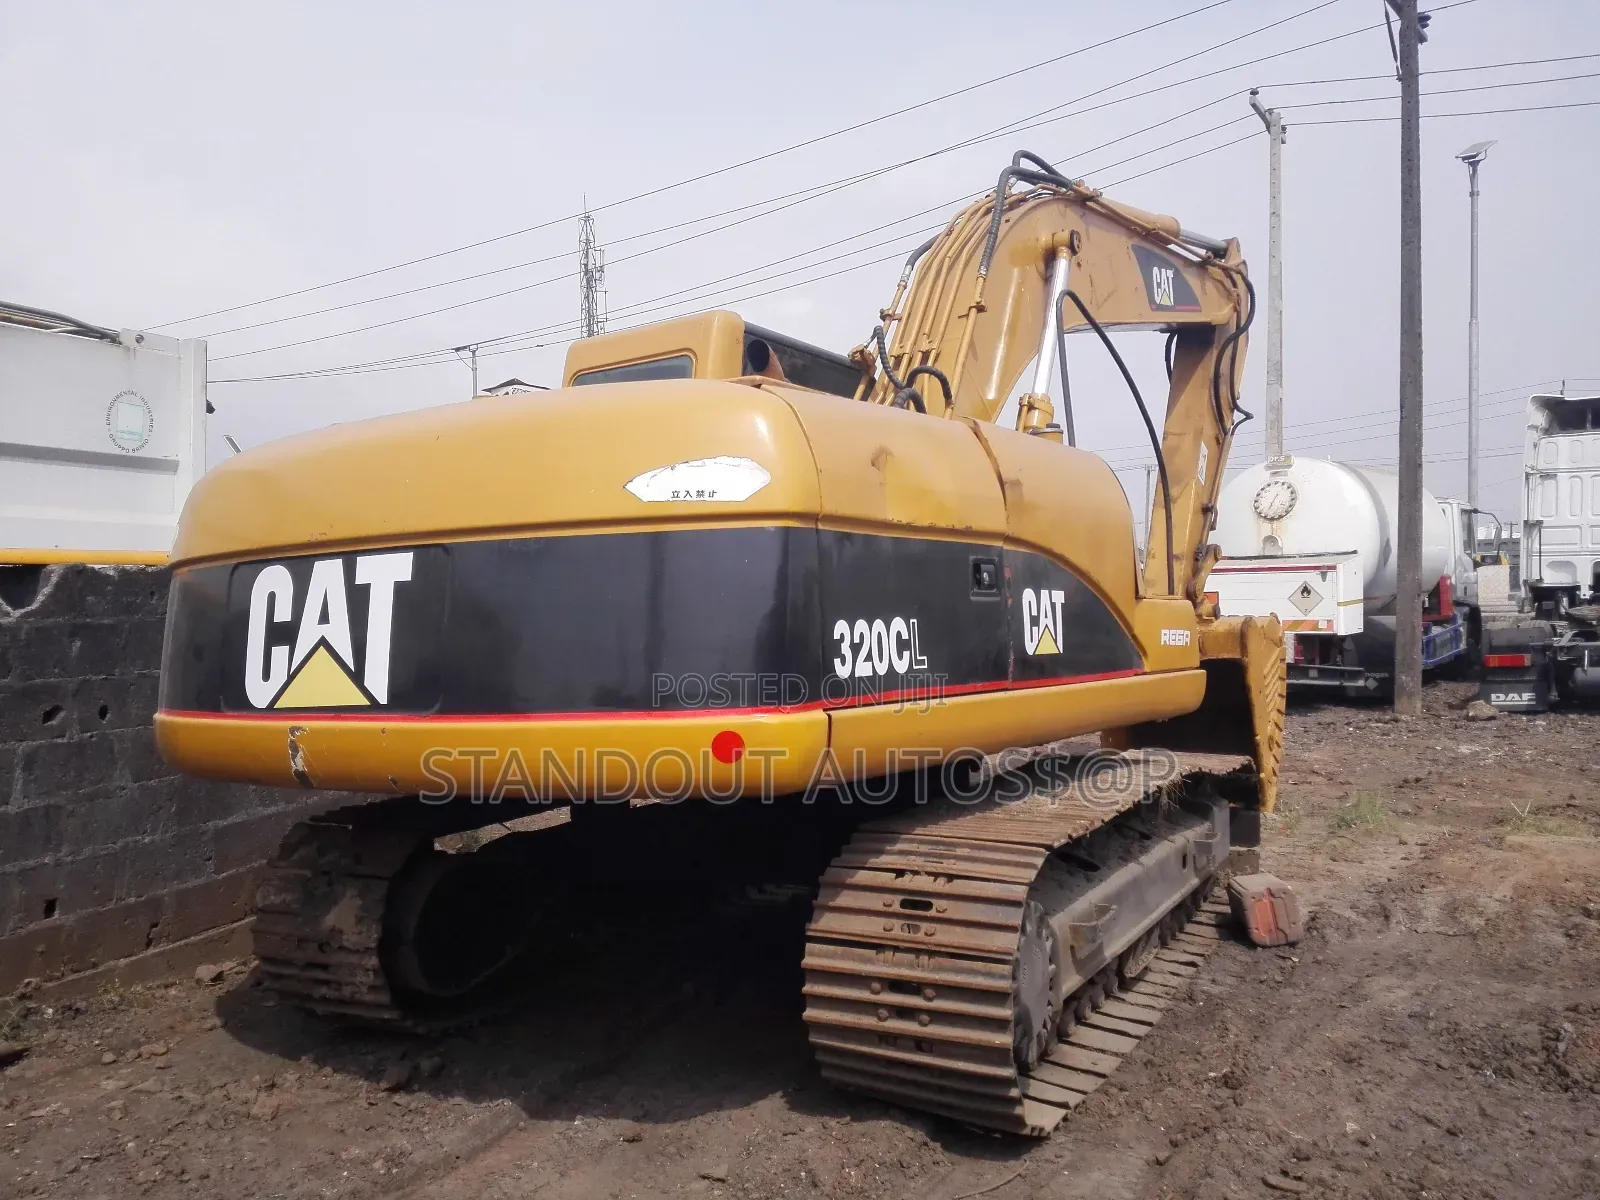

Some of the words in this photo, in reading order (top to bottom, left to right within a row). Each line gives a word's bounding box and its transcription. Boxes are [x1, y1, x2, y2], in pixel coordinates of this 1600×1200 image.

[1153, 267, 1174, 306] CAT
[671, 490, 717, 499] 立入禁止
[245, 552, 413, 709] CAT
[1022, 588, 1065, 655] CAT
[1490, 692, 1536, 702] DAF
